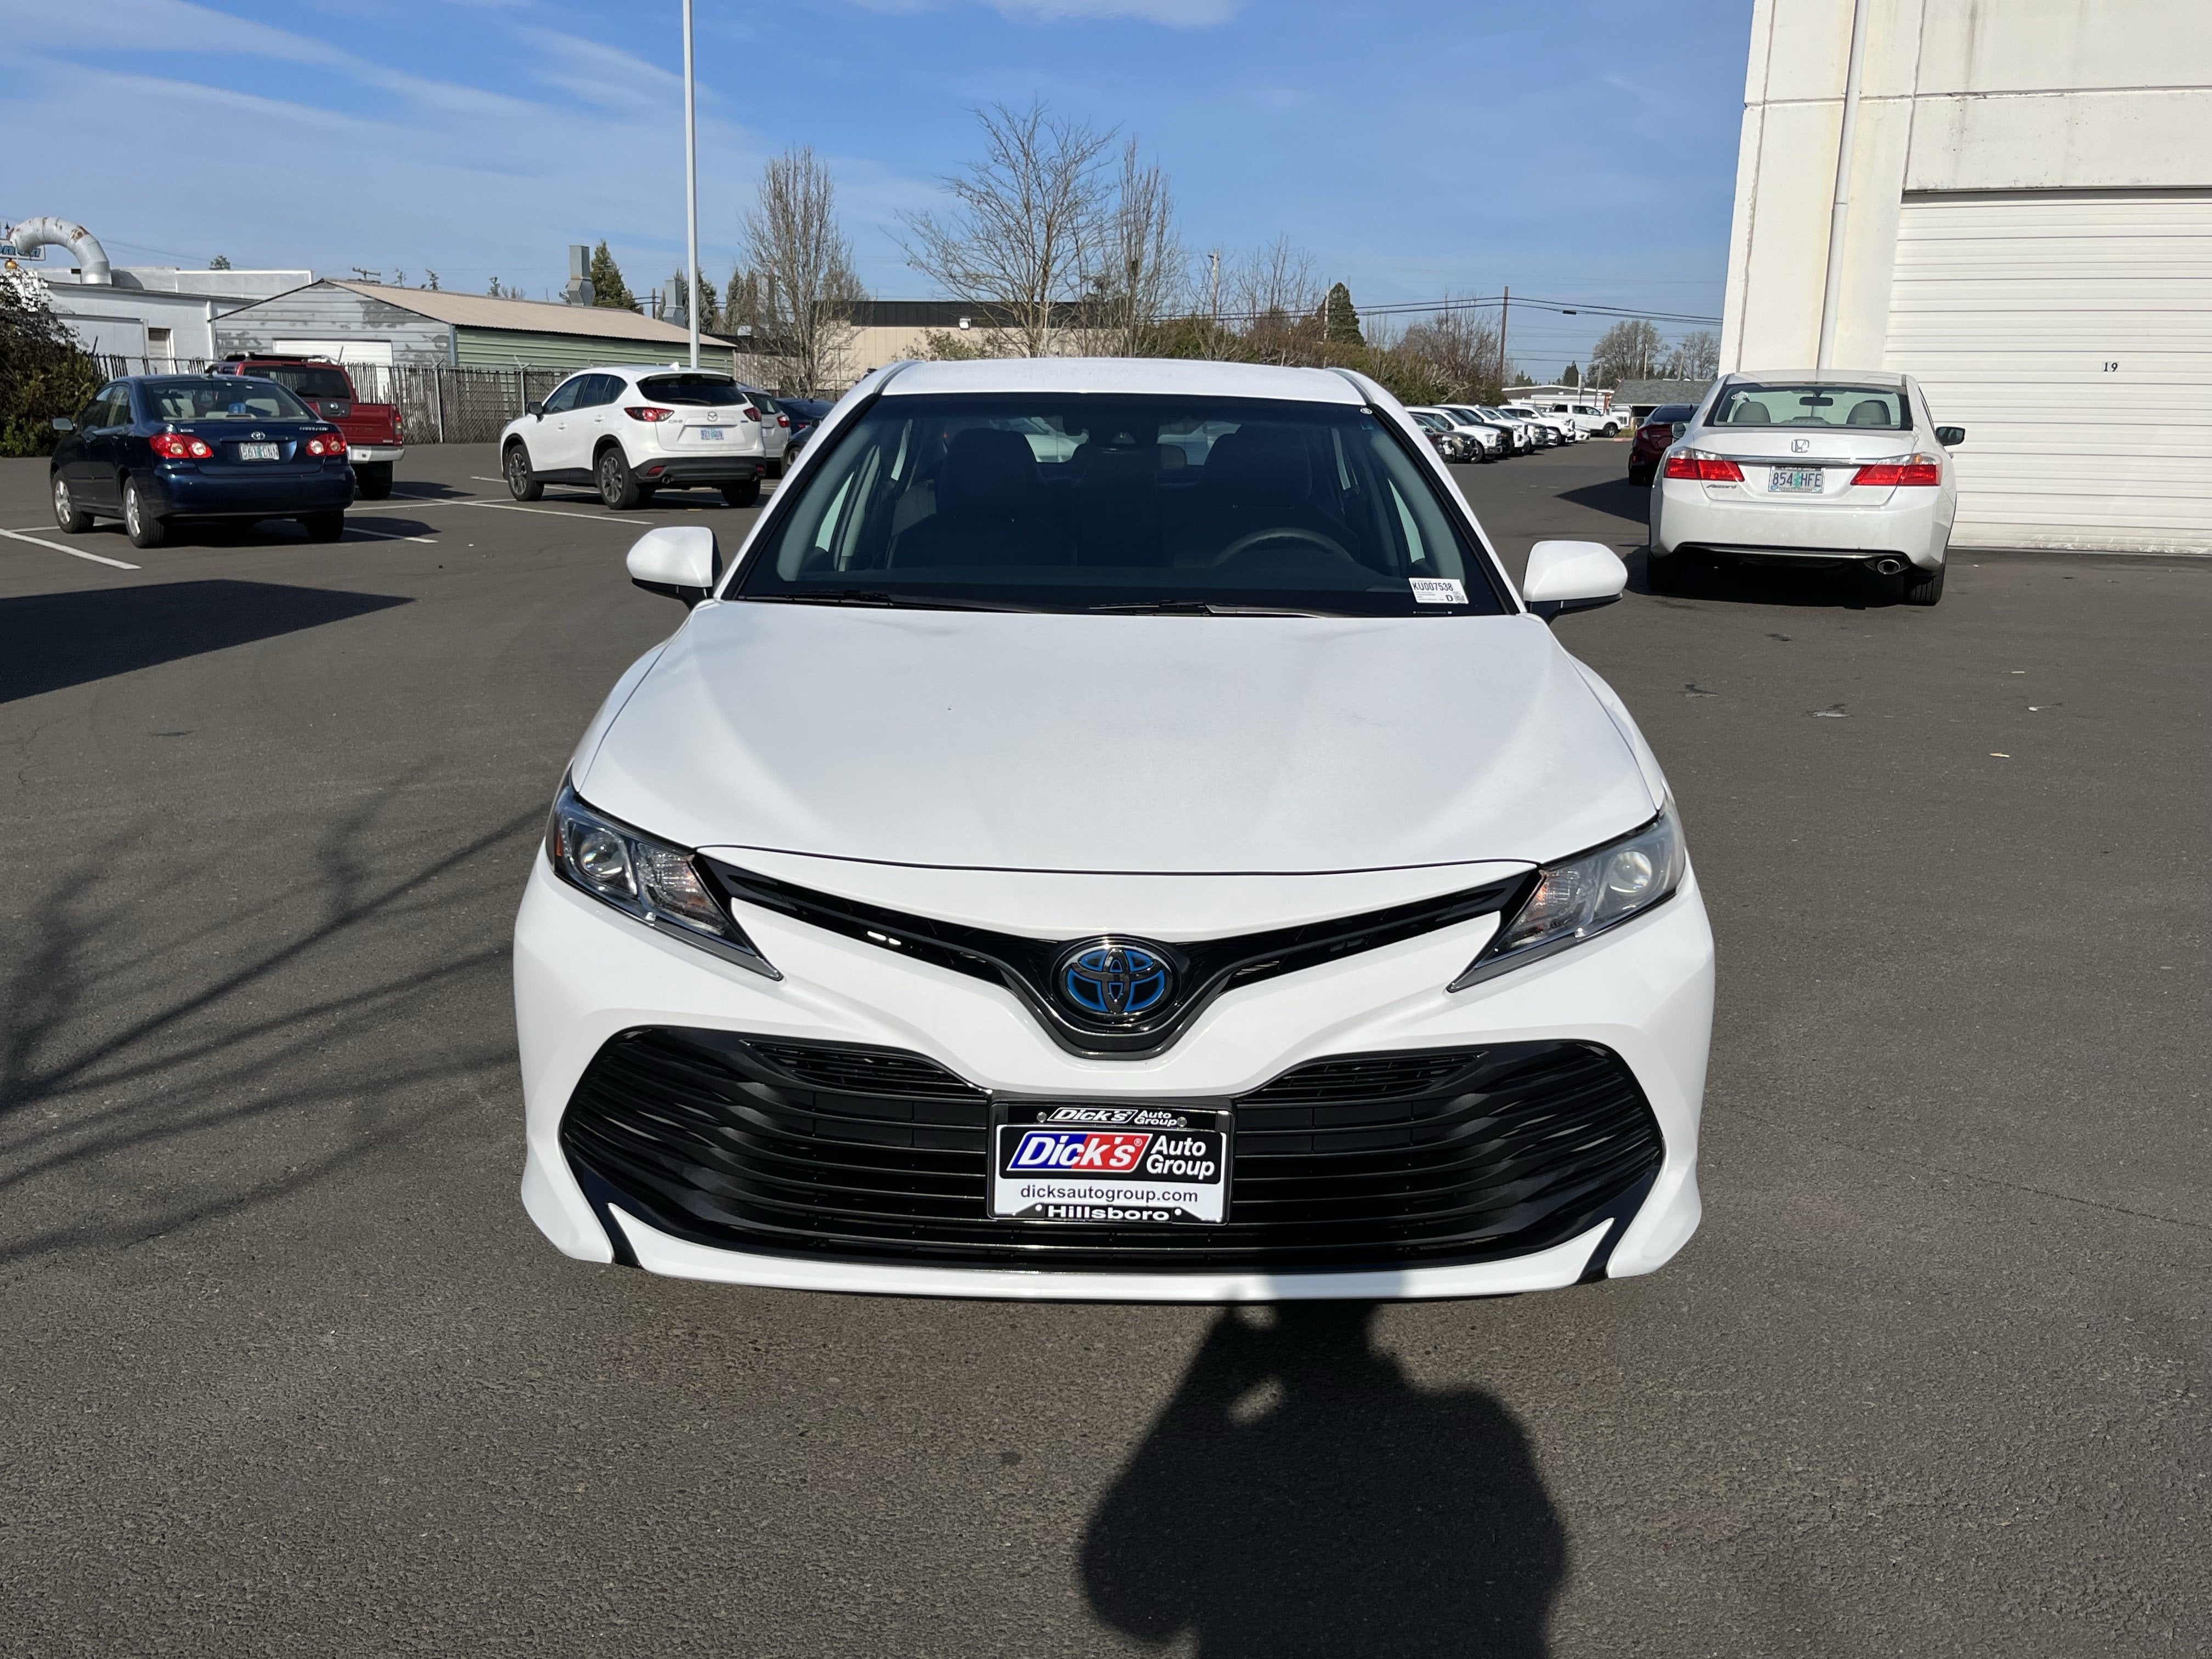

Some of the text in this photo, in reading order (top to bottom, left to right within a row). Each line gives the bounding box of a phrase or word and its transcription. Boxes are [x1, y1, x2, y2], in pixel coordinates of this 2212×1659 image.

[2103, 362, 2118, 372] 19
[1773, 472, 1822, 487] 854 HFE
[1412, 582, 1453, 591] KU007538
[1134, 1117, 1177, 1127] Group
[1137, 1110, 1172, 1119] Auto
[1150, 1135, 1206, 1156] Auto
[1146, 1154, 1215, 1180] Group
[1020, 1184, 1198, 1204] dicksautogroup.com
[1048, 1205, 1170, 1221] Hillsboro
